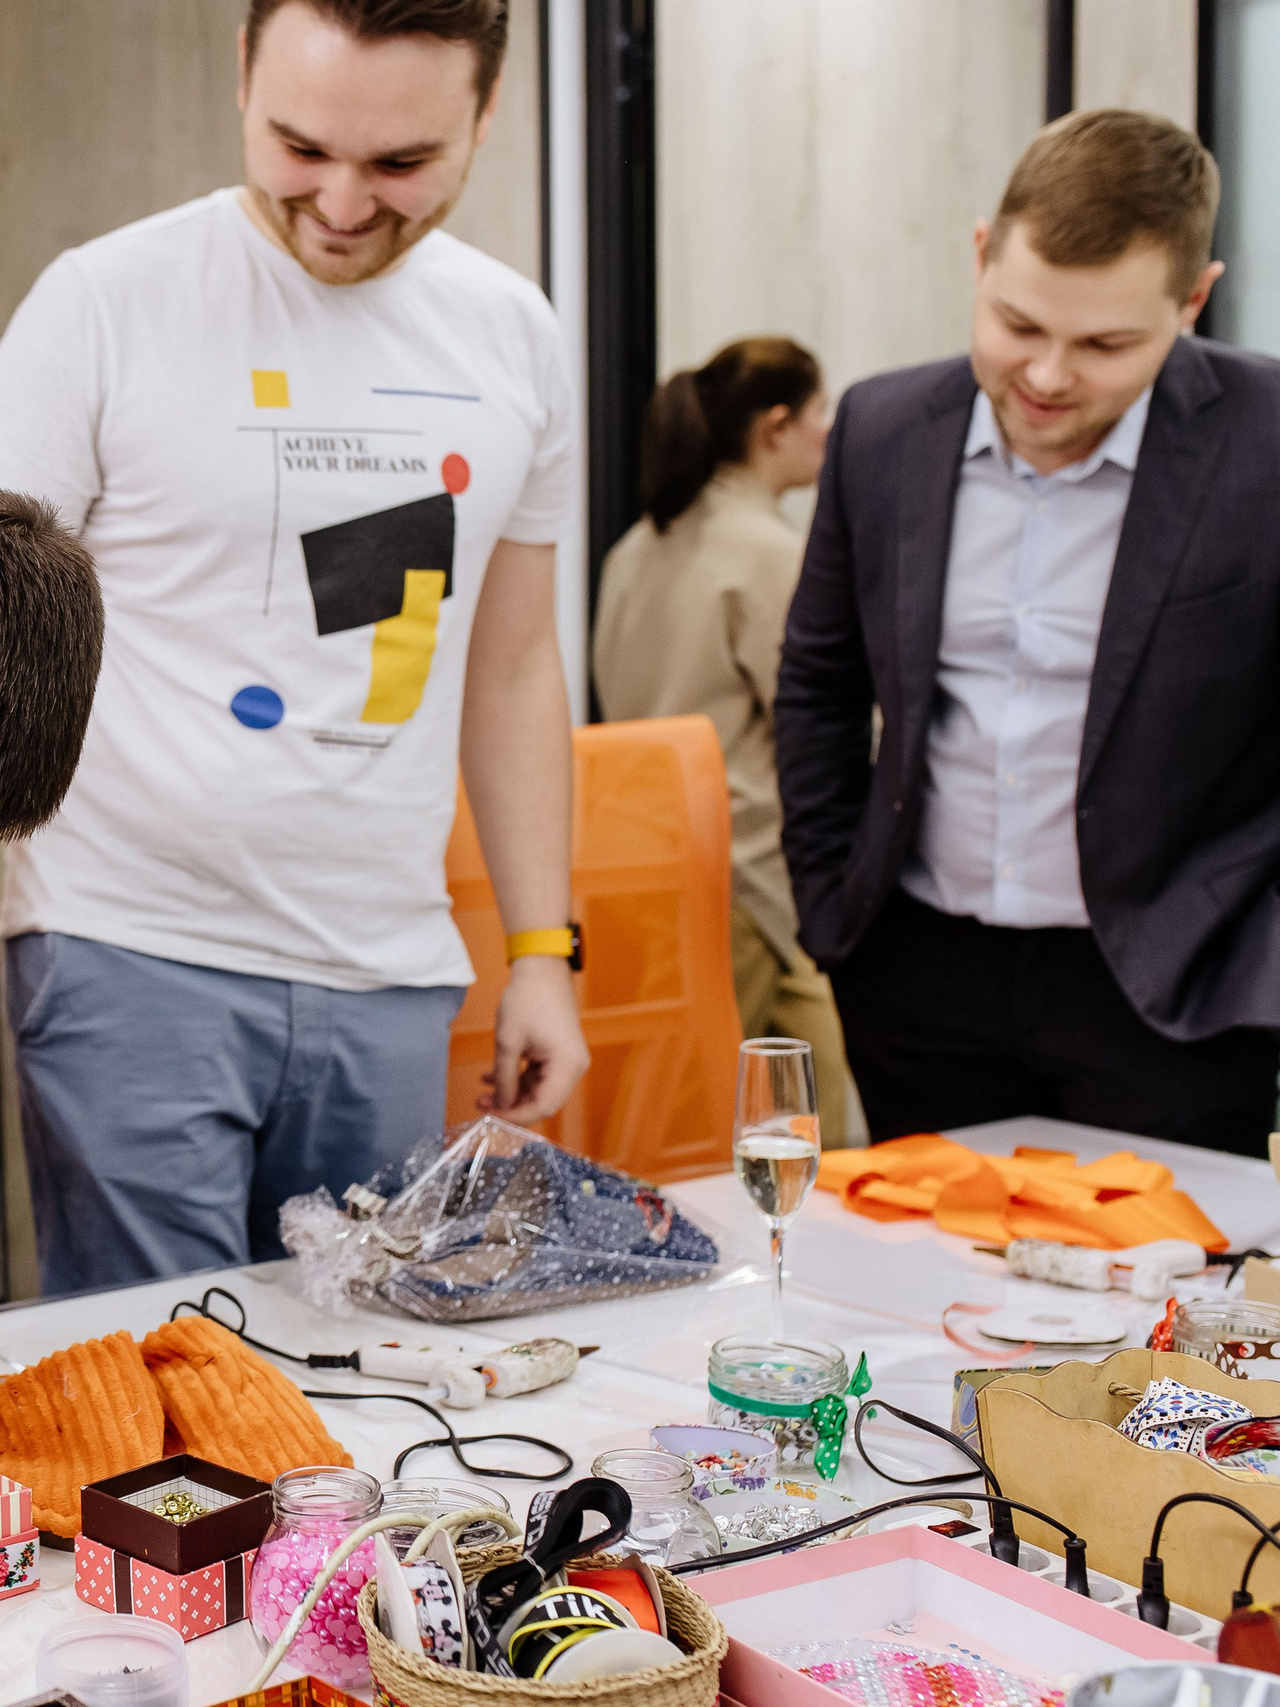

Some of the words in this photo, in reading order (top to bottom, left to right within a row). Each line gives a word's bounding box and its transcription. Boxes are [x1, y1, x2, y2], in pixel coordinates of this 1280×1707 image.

[284, 437, 368, 453] ACHIEVE
[283, 455, 339, 471] YOUR
[345, 456, 428, 473] DREAMS
